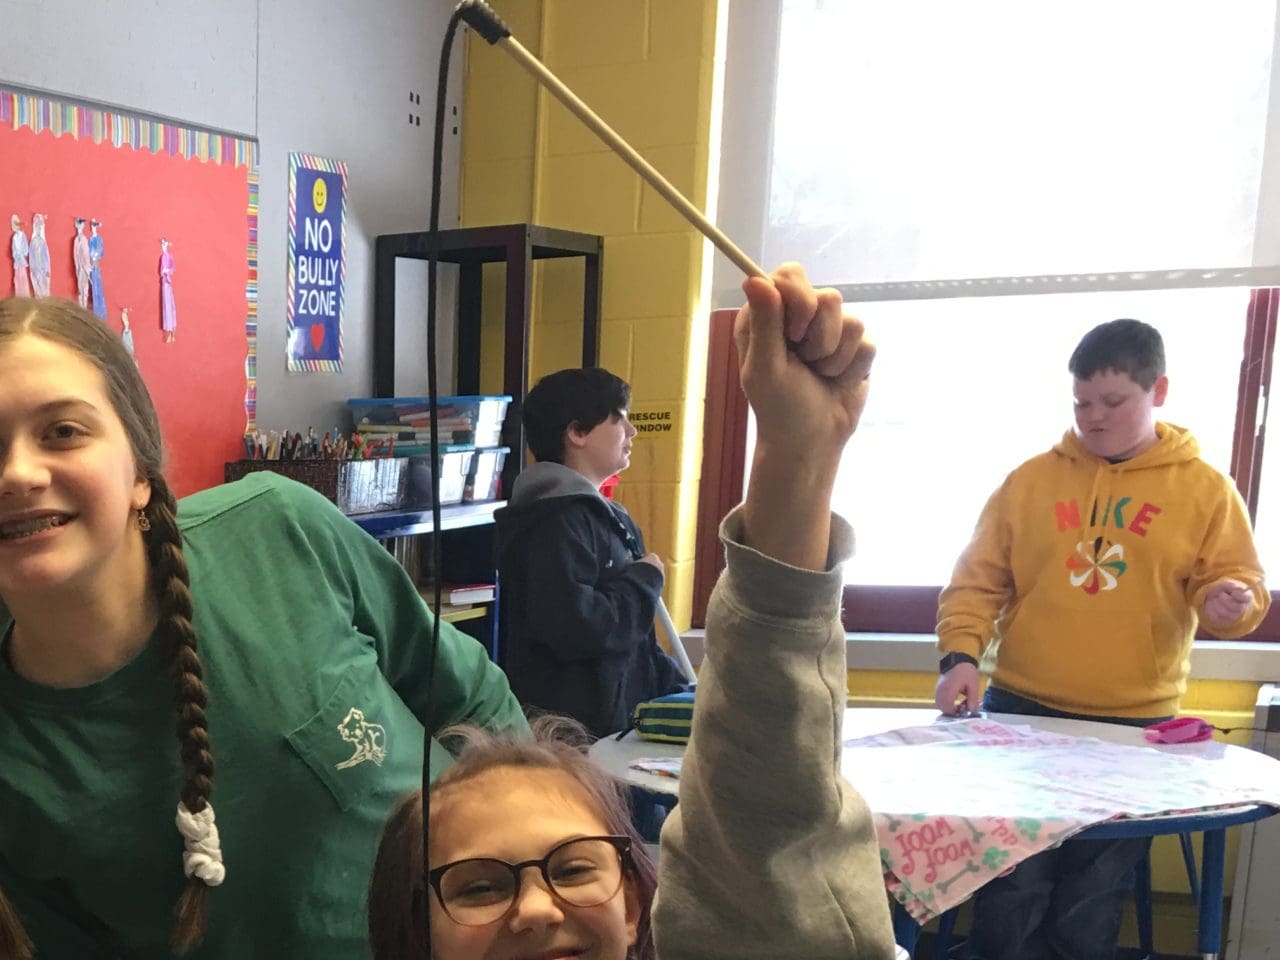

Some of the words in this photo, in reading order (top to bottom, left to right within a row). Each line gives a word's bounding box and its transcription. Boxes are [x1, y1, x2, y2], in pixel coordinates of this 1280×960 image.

[304, 217, 333, 252] NO
[297, 256, 339, 286] BULLY
[298, 290, 336, 316] ZONE
[628, 412, 672, 421] RESCUE
[1054, 495, 1163, 537] NIKE
[896, 816, 955, 876] woof
[924, 838, 976, 884] woof
